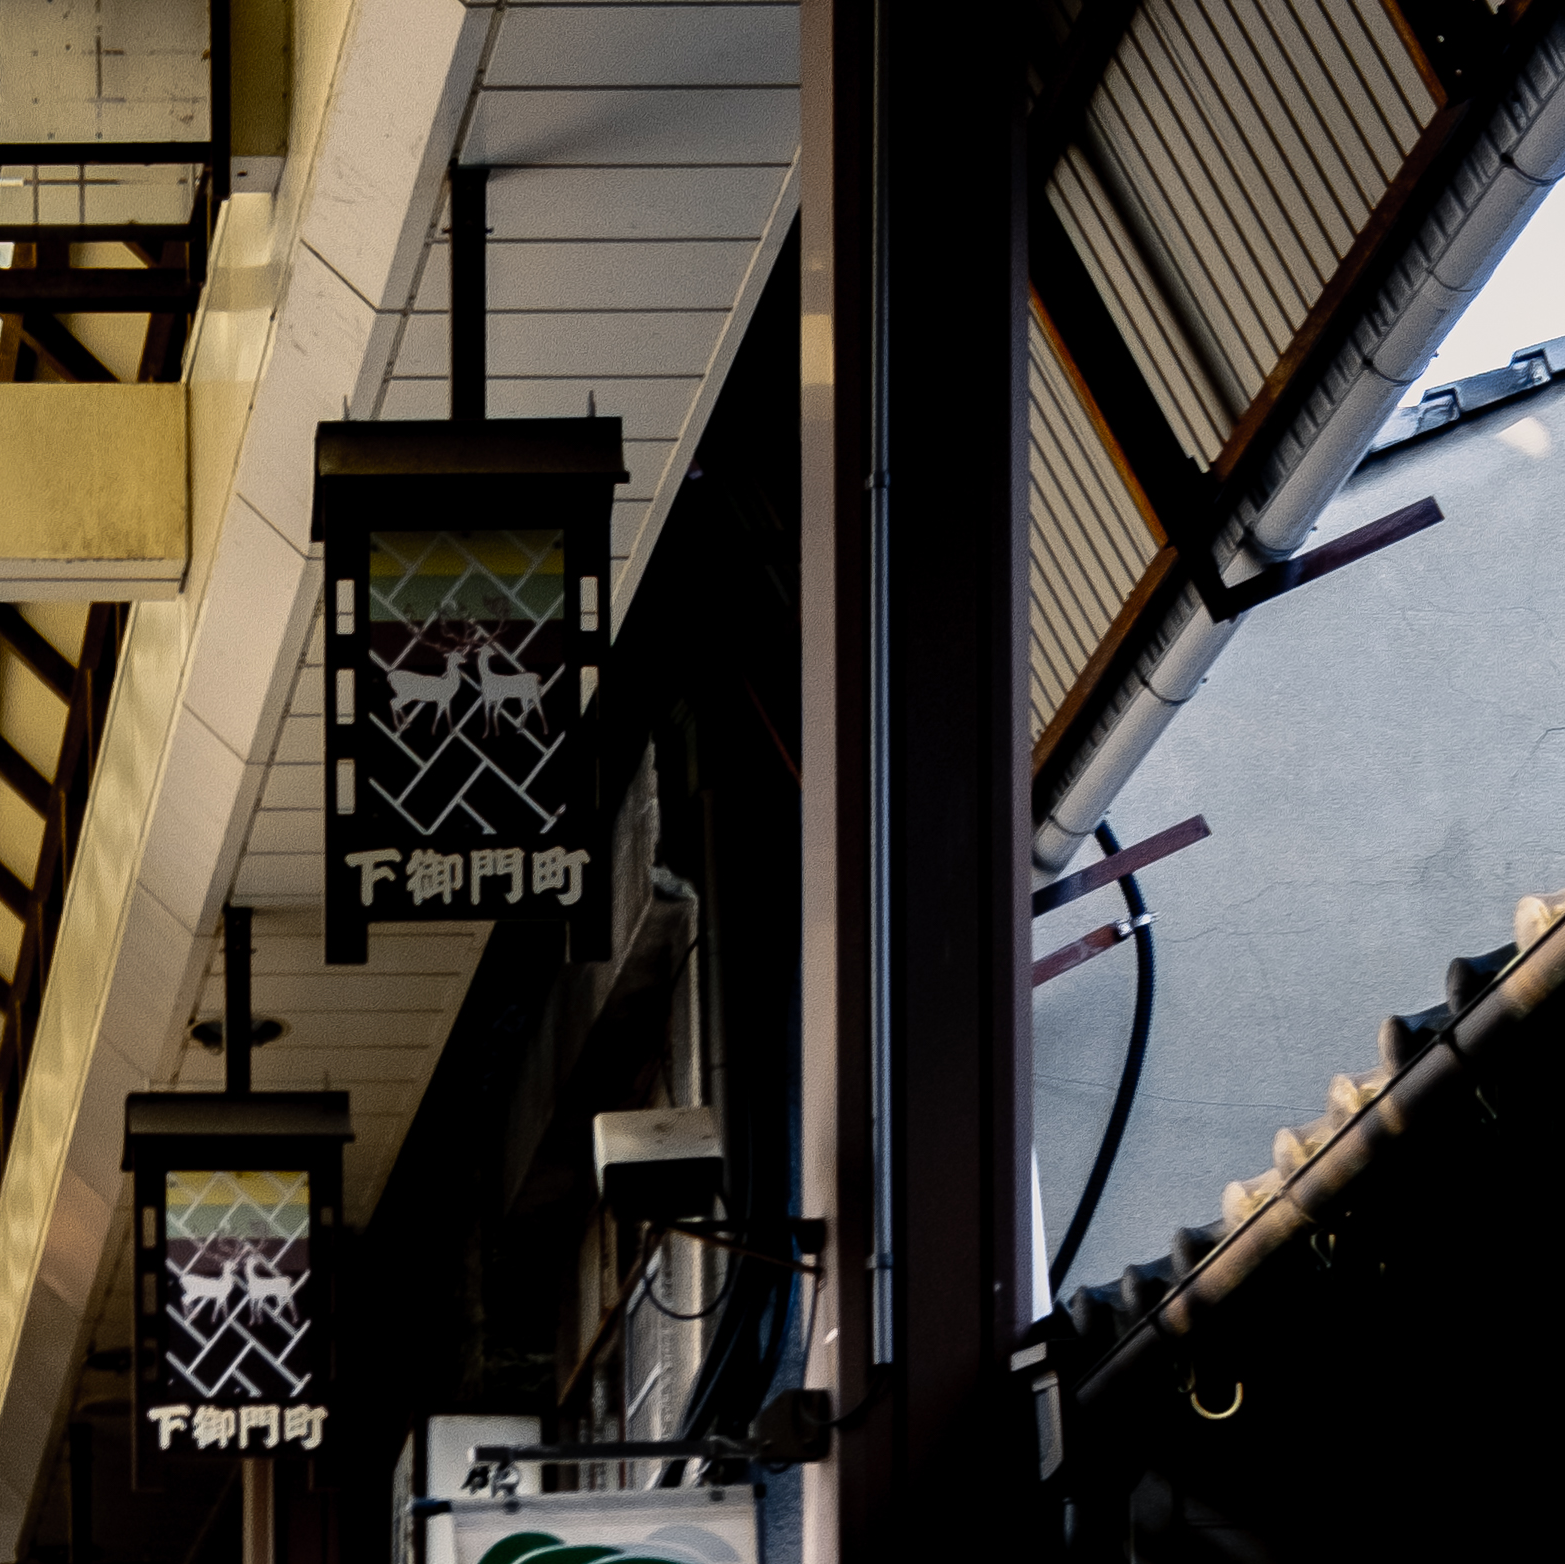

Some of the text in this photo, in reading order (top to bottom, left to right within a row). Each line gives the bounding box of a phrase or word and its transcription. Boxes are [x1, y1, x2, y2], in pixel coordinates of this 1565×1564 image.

[344, 846, 591, 906] 下御門町
[147, 1404, 329, 1450] 下御門町
